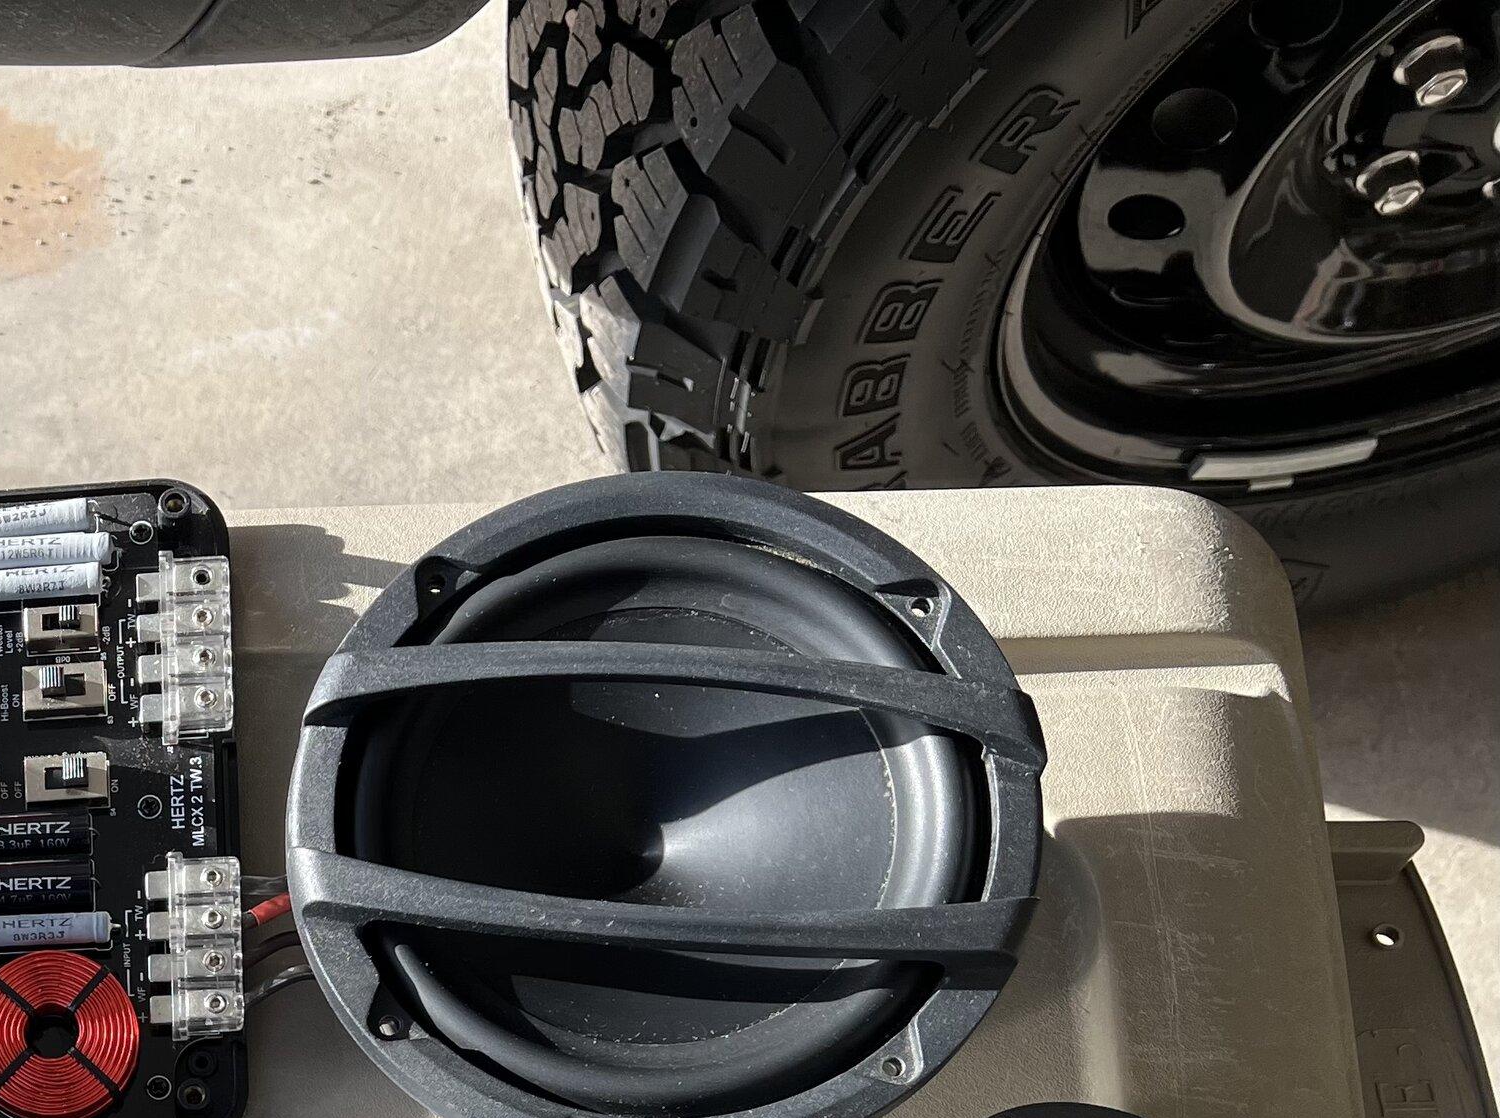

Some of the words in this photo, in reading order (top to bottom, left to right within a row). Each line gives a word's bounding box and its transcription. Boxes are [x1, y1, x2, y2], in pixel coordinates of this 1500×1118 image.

[832, 82, 1080, 492] ABBER
[117, 646, 125, 678] OUTPUT
[13, 694, 20, 707] ON
[190, 756, 202, 792] TW.3
[170, 775, 185, 830] HERTZ
[192, 805, 204, 847] MLCX
[2, 918, 73, 928] HERTZ
